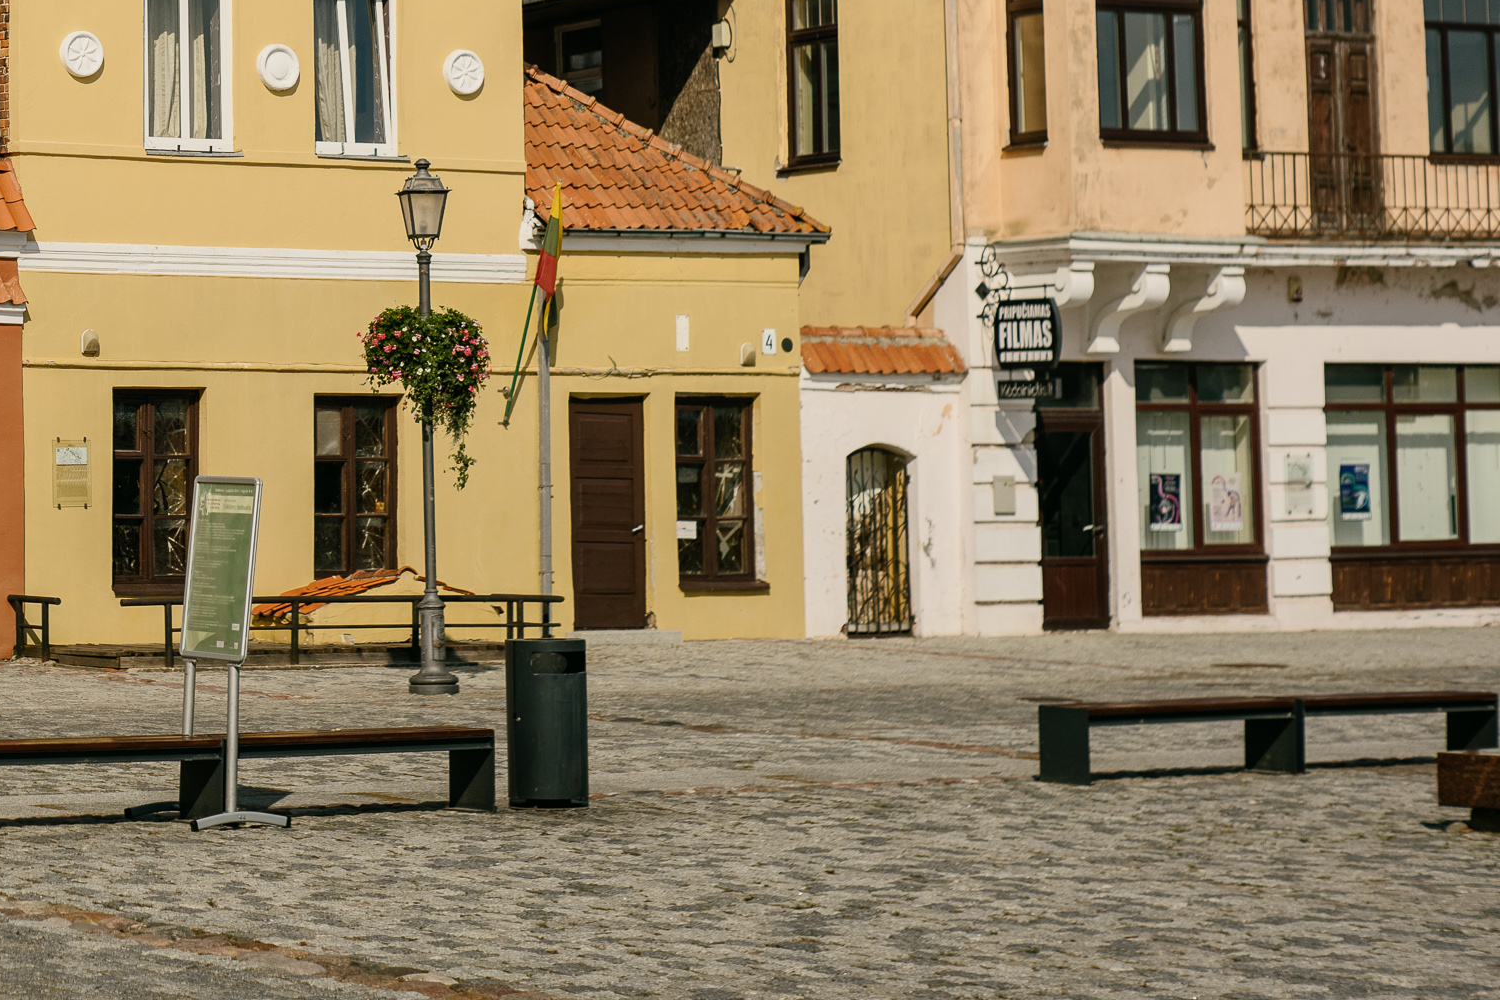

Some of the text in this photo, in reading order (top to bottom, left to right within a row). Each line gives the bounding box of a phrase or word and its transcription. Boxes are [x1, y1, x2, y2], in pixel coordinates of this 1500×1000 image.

[999, 302, 1051, 320] PRIPUČIAMAS
[765, 334, 773, 350] 4
[999, 320, 1053, 350] FILMAS
